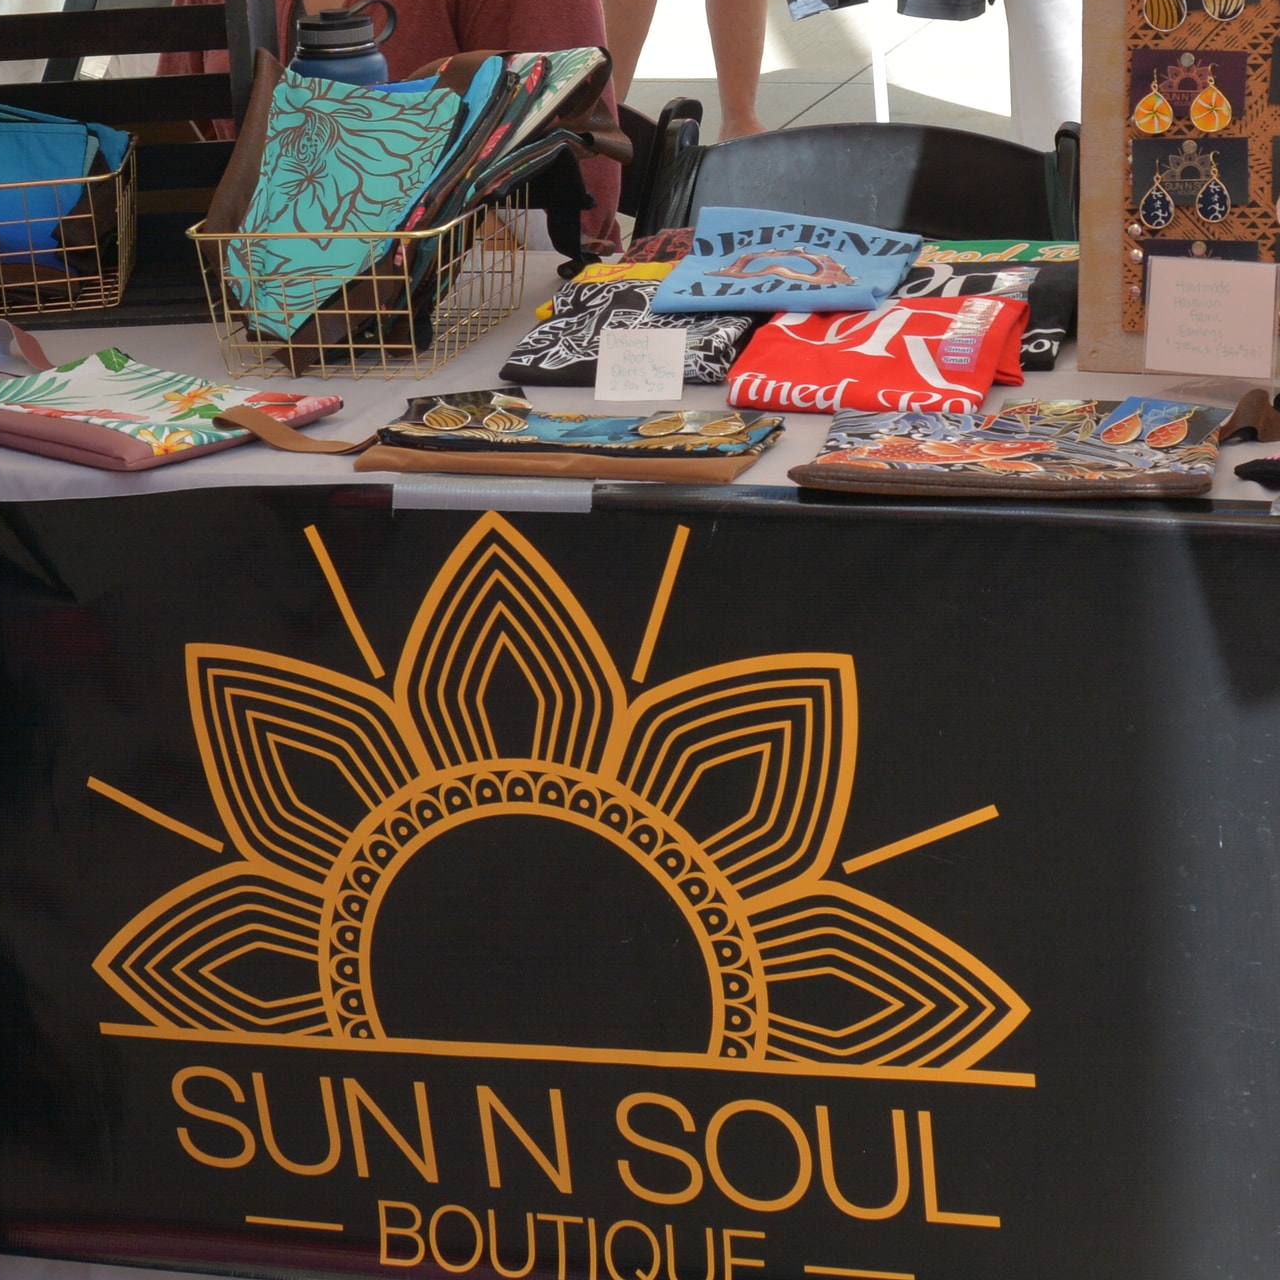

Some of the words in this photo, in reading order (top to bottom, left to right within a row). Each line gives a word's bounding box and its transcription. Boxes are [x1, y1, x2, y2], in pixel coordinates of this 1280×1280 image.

[1165, 183, 1183, 191] SUN
[170, 1065, 440, 1184] SUN
[475, 1084, 572, 1197] N
[614, 1090, 1001, 1230] SOUL
[377, 1199, 767, 1280] BOUTIQUE
